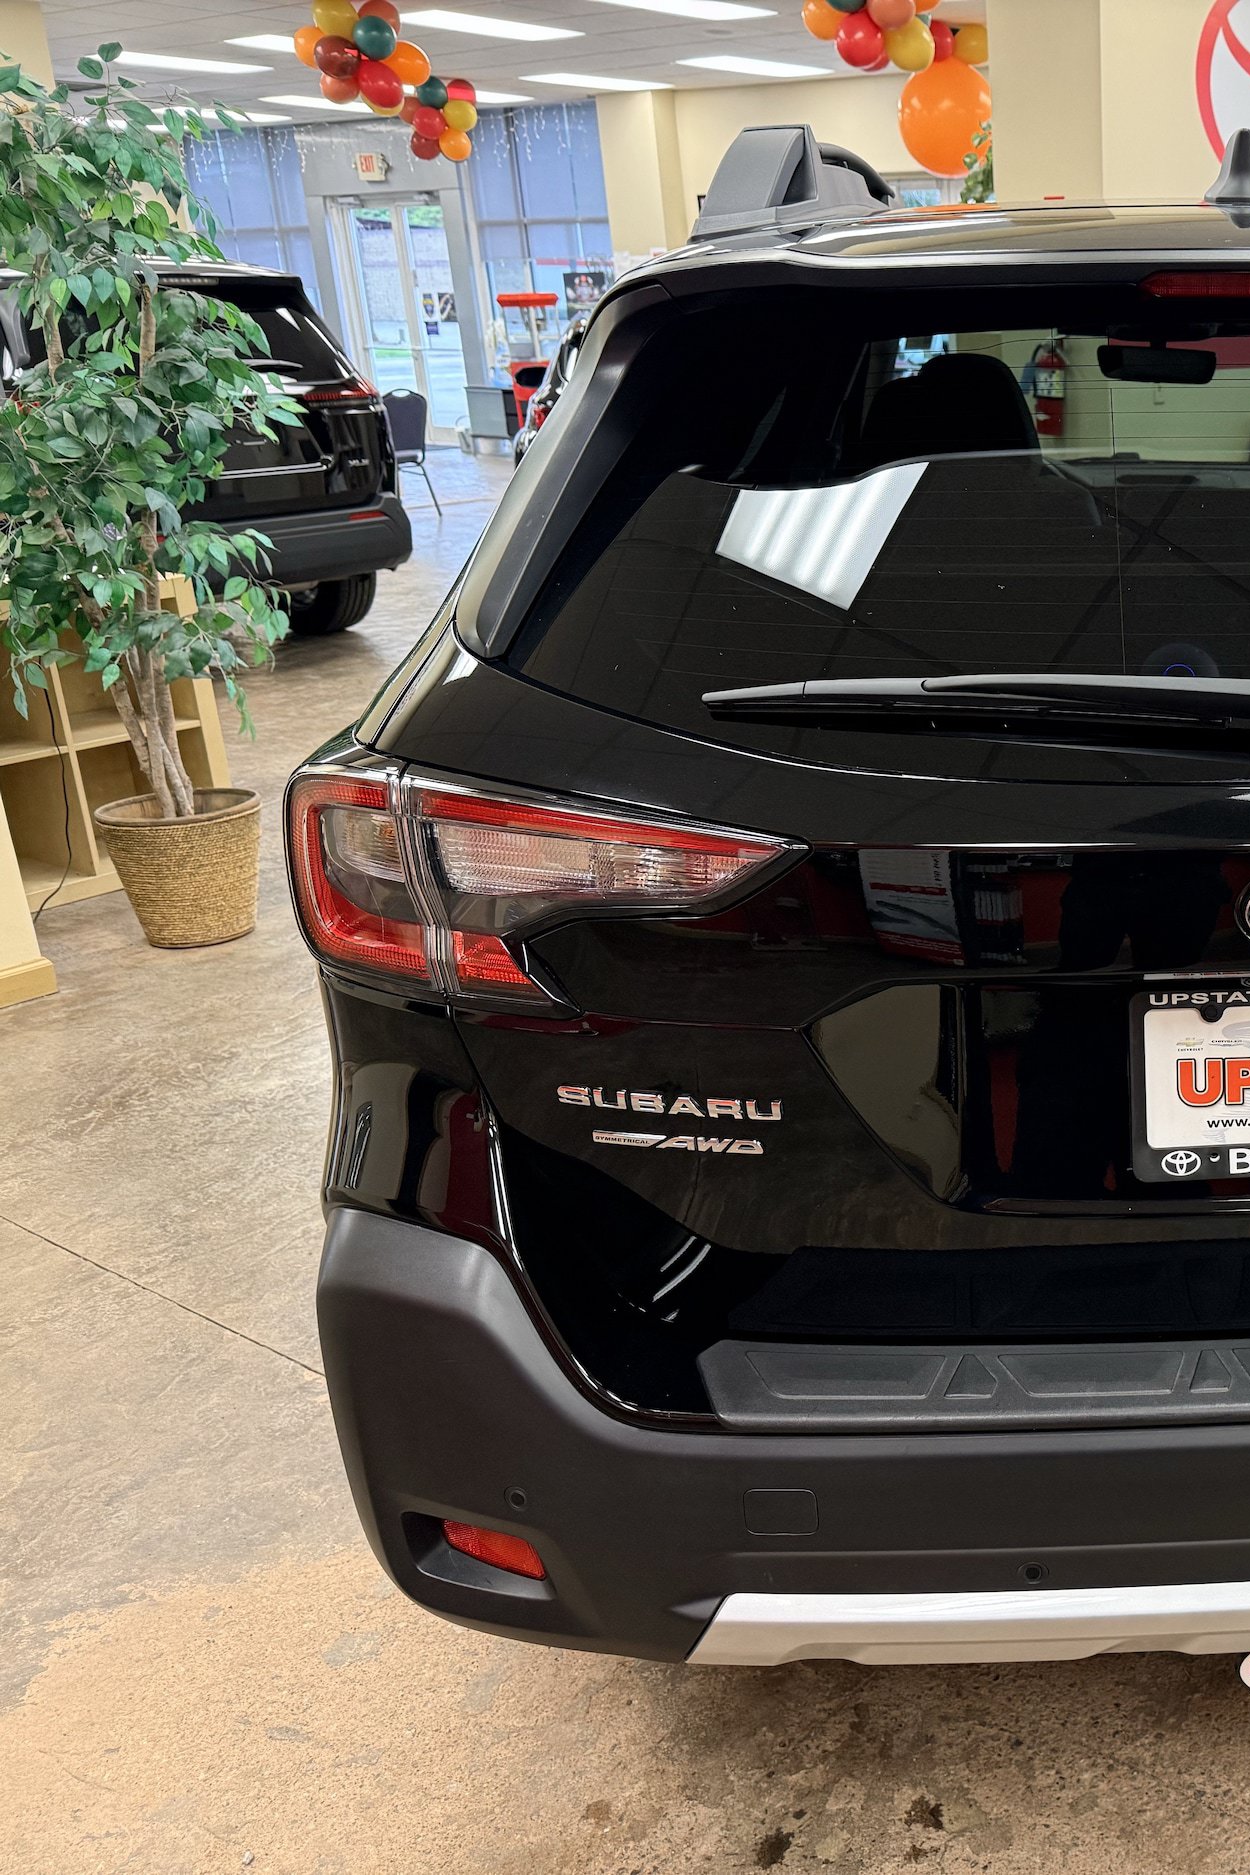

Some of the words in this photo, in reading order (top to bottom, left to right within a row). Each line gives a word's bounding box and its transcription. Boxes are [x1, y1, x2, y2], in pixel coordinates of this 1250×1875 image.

[359, 154, 376, 173] EXIT
[556, 1084, 784, 1121] SUBARU
[594, 1134, 652, 1146] SYMMETRICAL
[656, 1135, 764, 1155] AWD
